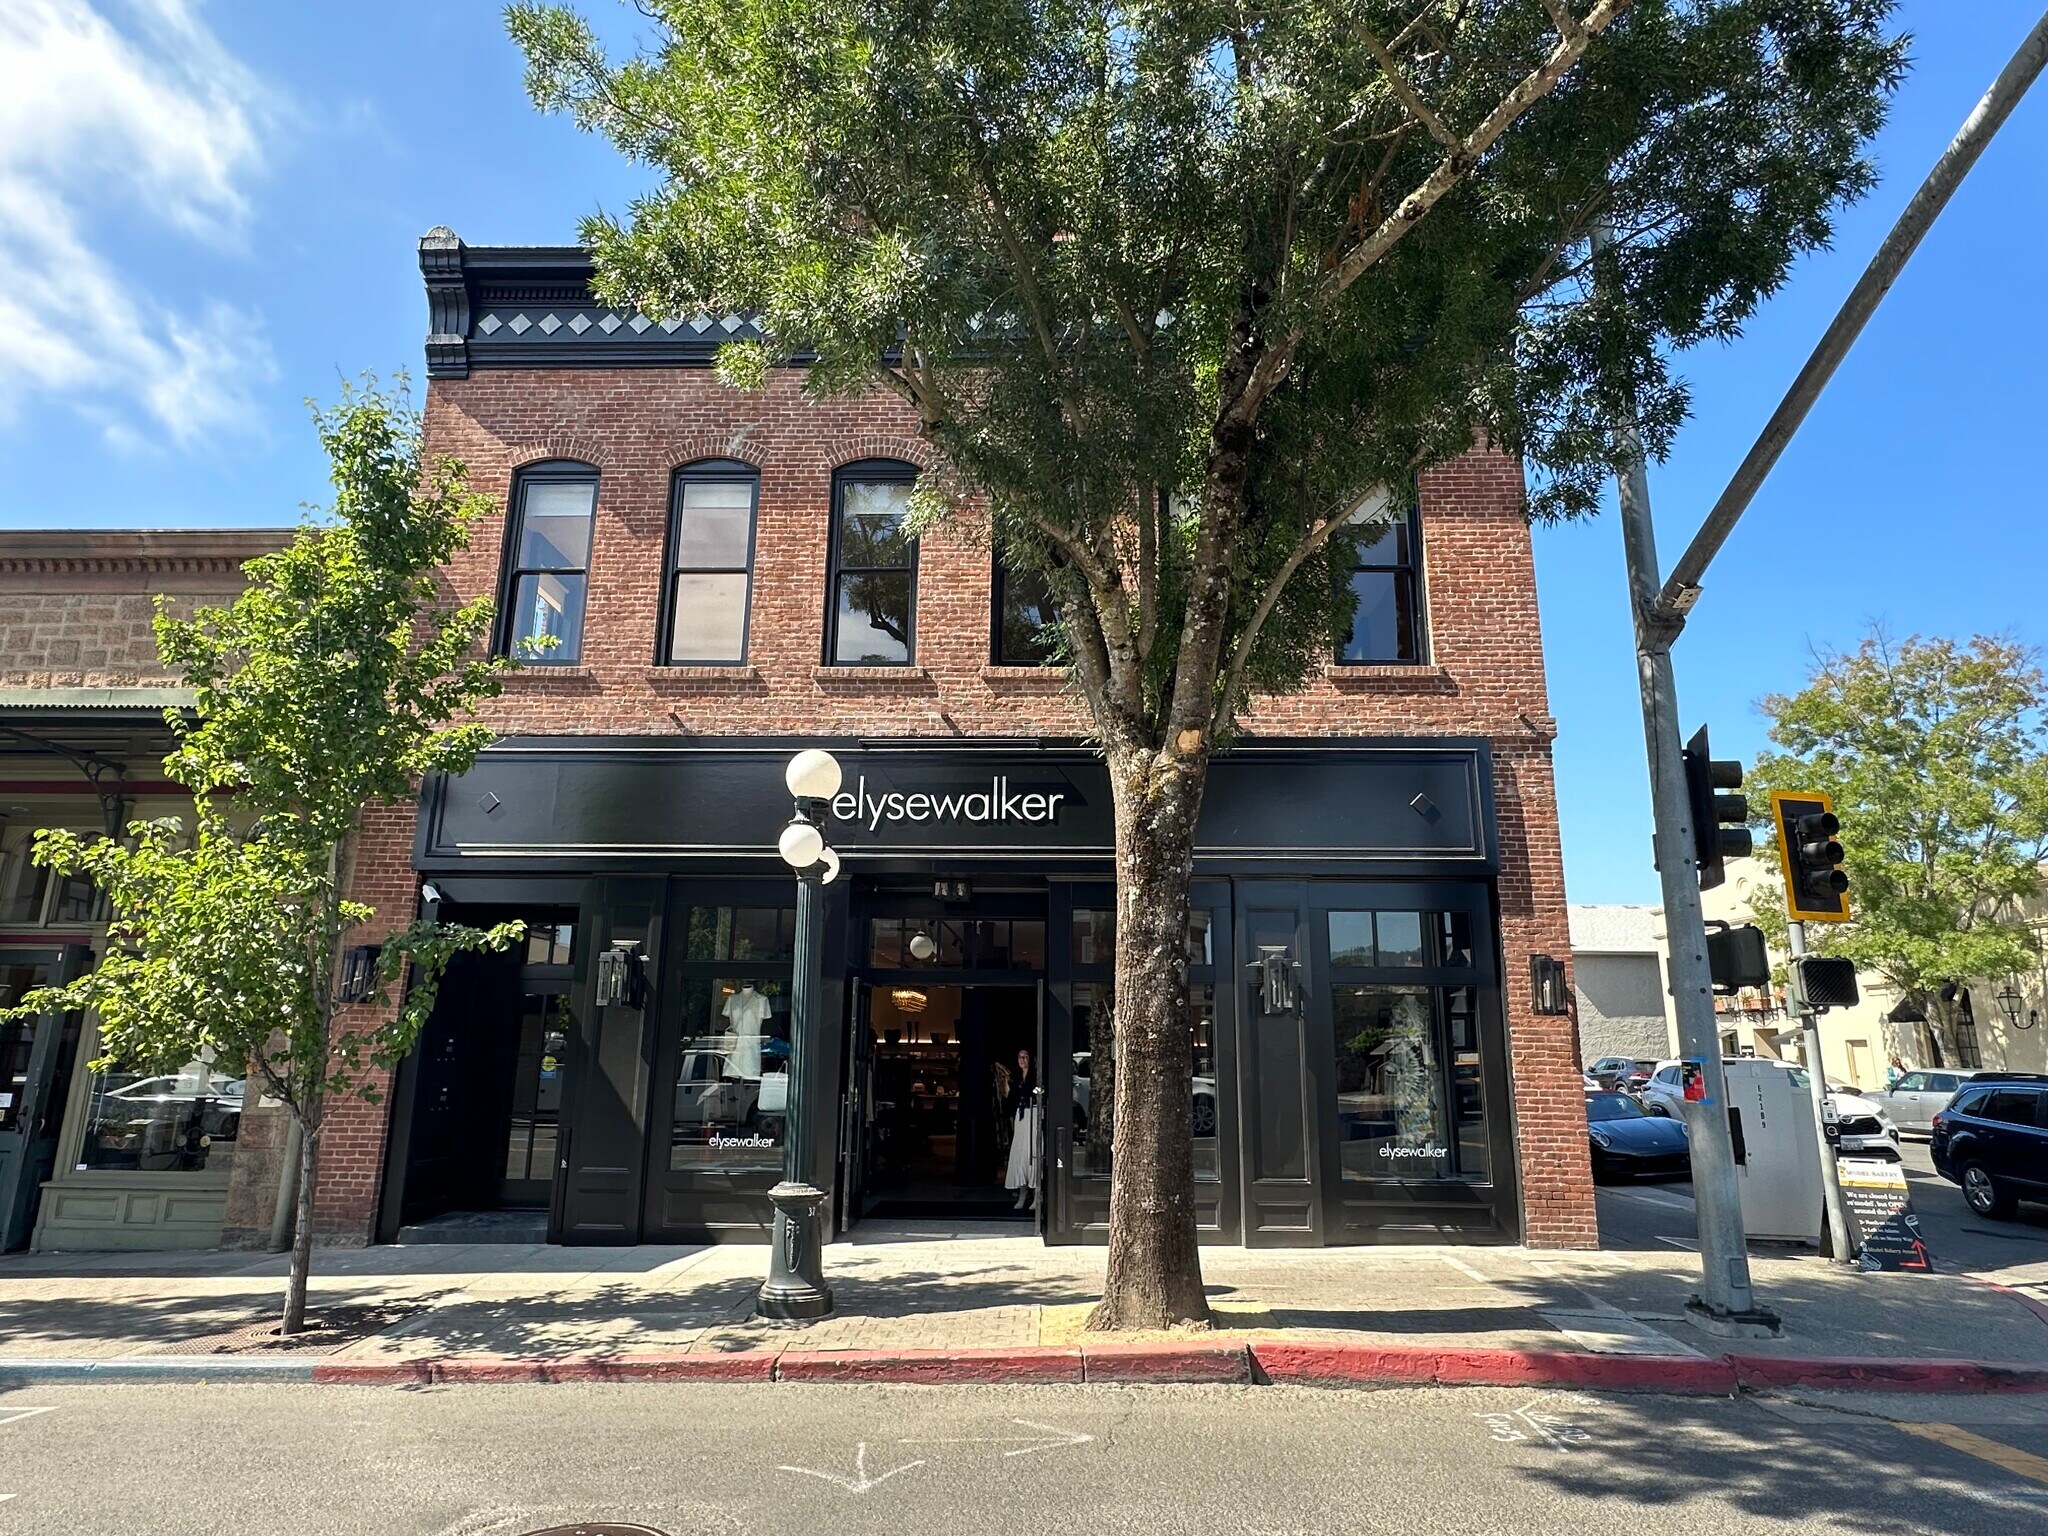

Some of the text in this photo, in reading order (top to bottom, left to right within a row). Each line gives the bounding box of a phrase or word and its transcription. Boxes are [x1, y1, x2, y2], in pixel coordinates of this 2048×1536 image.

[832, 775, 1064, 831] elysewalker
[708, 1131, 775, 1150] elysewalker
[1379, 1142, 1447, 1161] elysewalker
[1876, 1208, 1887, 1216] the
